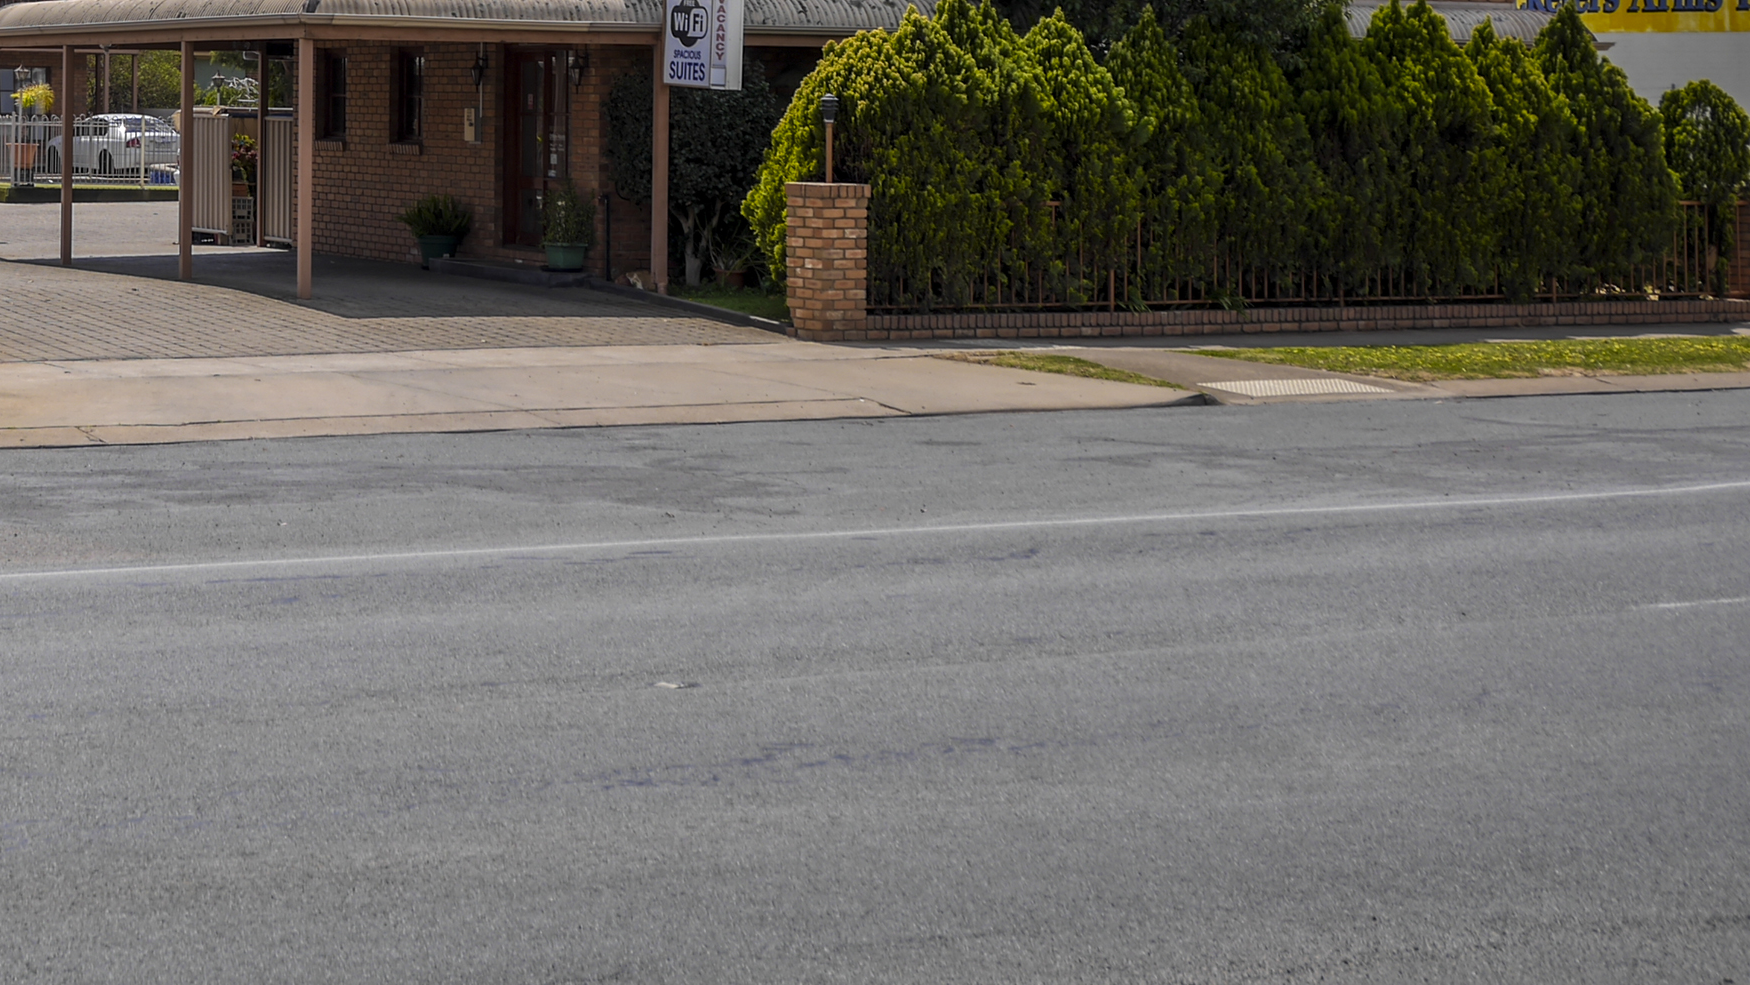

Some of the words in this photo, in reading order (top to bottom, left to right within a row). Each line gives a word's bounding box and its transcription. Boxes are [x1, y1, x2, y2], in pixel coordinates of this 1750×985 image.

[683, 0, 696, 7] FREE
[673, 49, 702, 60] SPACIOUS
[669, 61, 706, 82] SUITES
